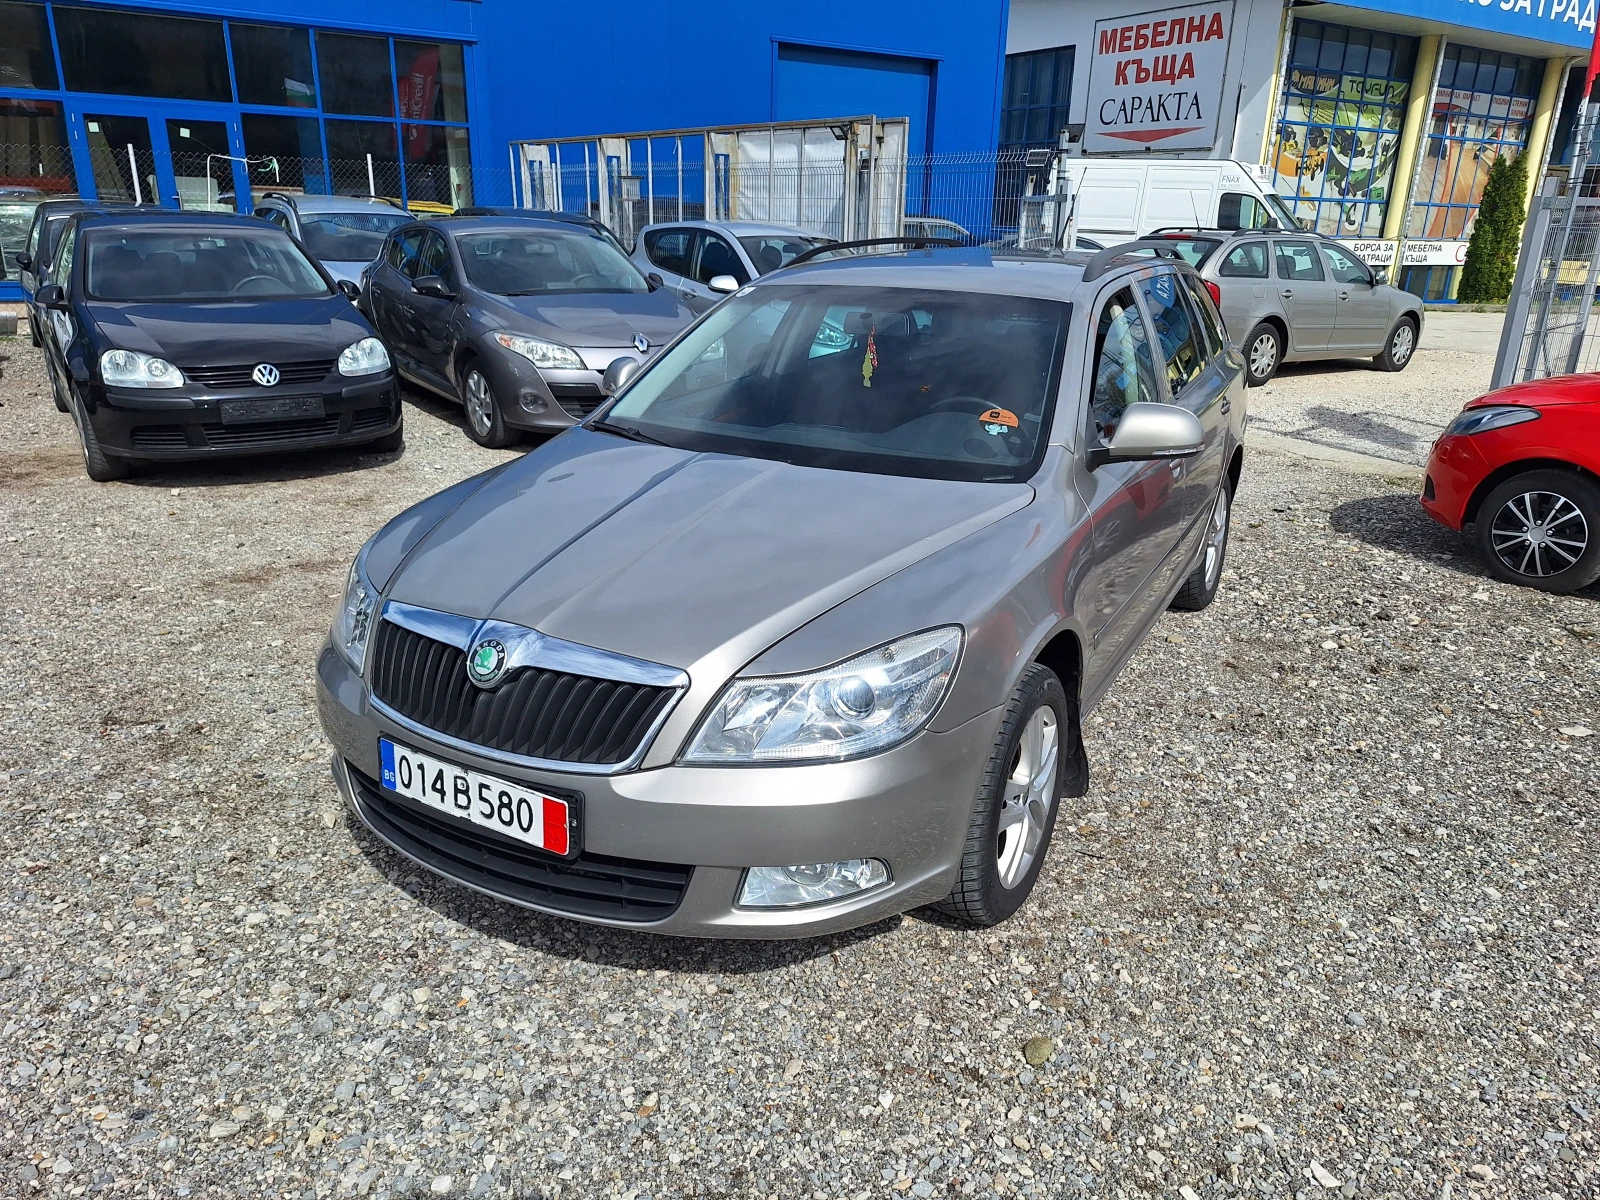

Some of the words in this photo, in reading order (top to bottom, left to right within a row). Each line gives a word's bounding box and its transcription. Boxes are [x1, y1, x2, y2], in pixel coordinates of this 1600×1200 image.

[1098, 12, 1224, 55] МЕБЕЛНА
[1114, 52, 1195, 85] КЪЩА
[410, 73, 425, 127] niCredit
[1099, 91, 1202, 126] САРАКТА
[1353, 243, 1381, 252] БОРСА
[1383, 244, 1394, 252] ЗА
[1404, 254, 1428, 263] КЪЩА
[1406, 244, 1443, 253] МЕБЕЛНА
[384, 769, 395, 782] BG
